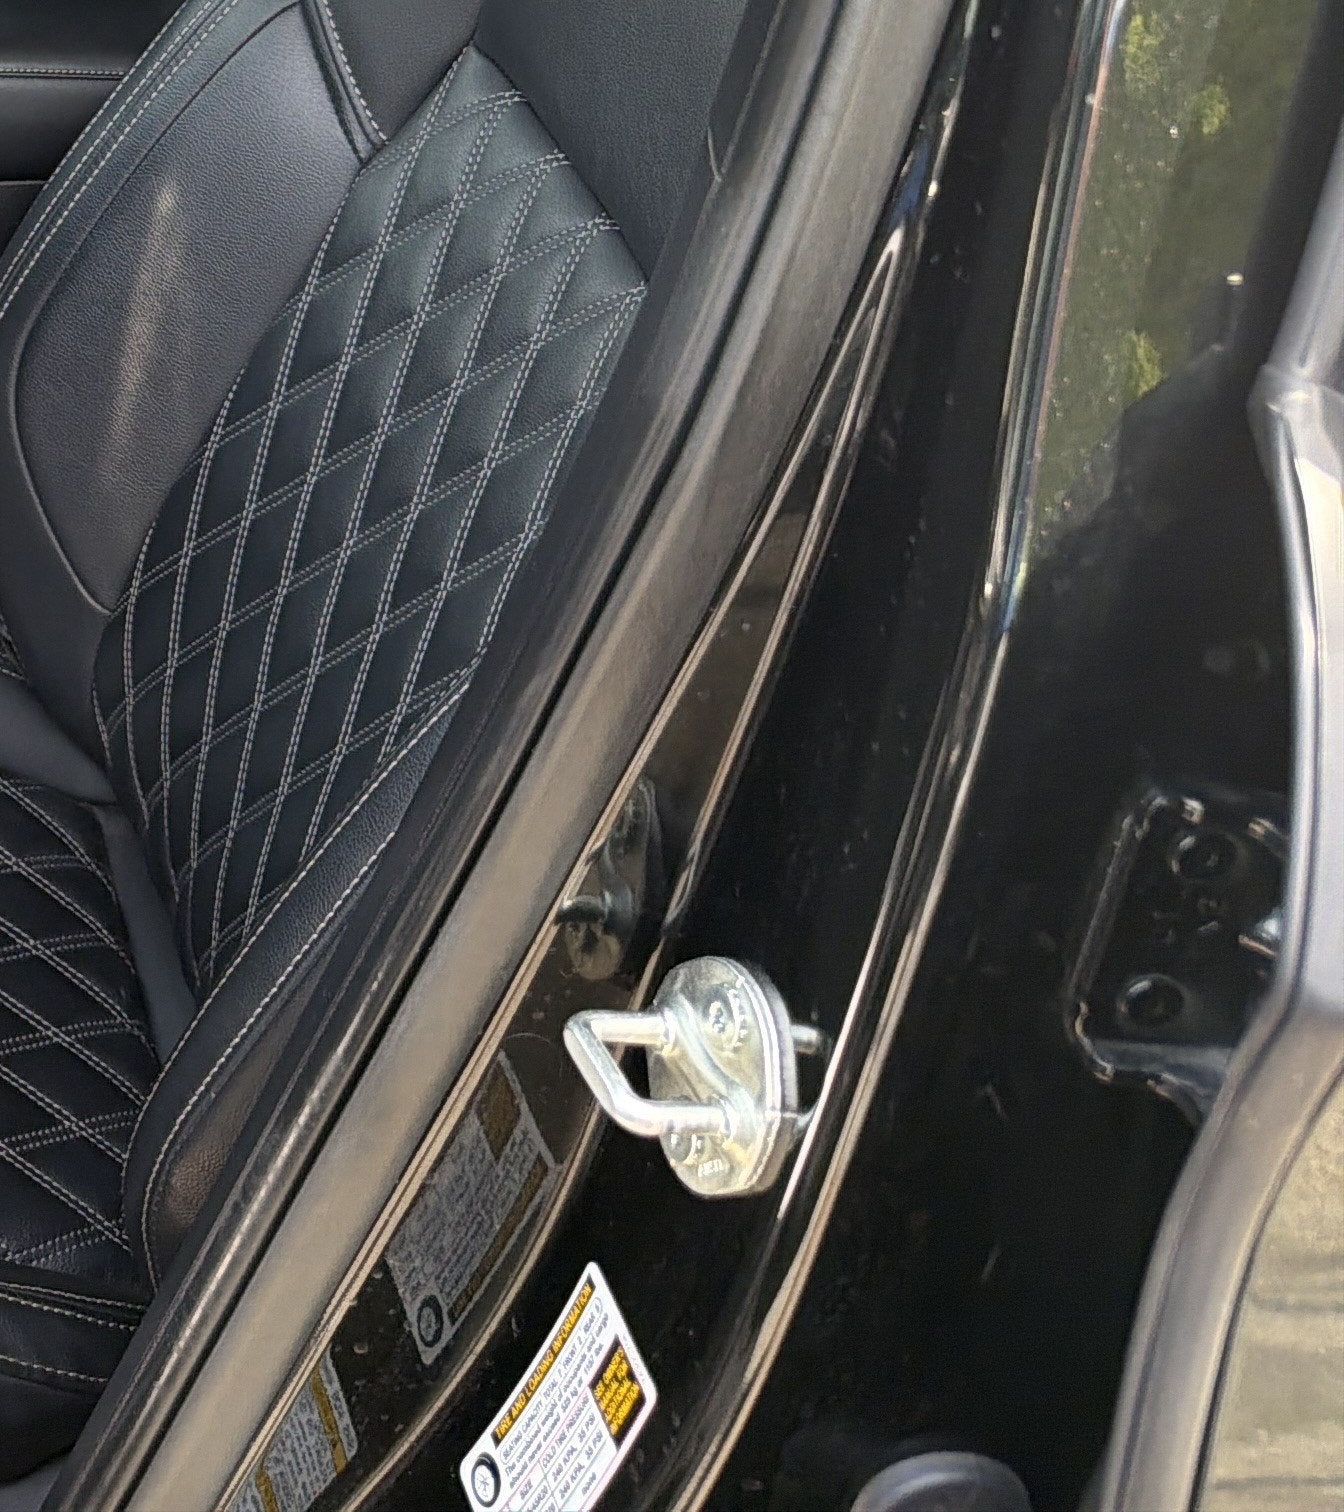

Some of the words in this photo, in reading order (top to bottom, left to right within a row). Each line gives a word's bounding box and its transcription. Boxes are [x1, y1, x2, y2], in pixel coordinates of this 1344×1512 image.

[496, 1412, 512, 1440] TIRE
[510, 1392, 527, 1419] AND
[525, 1350, 554, 1396] LOADING
[552, 1283, 591, 1353] INFORMATION
